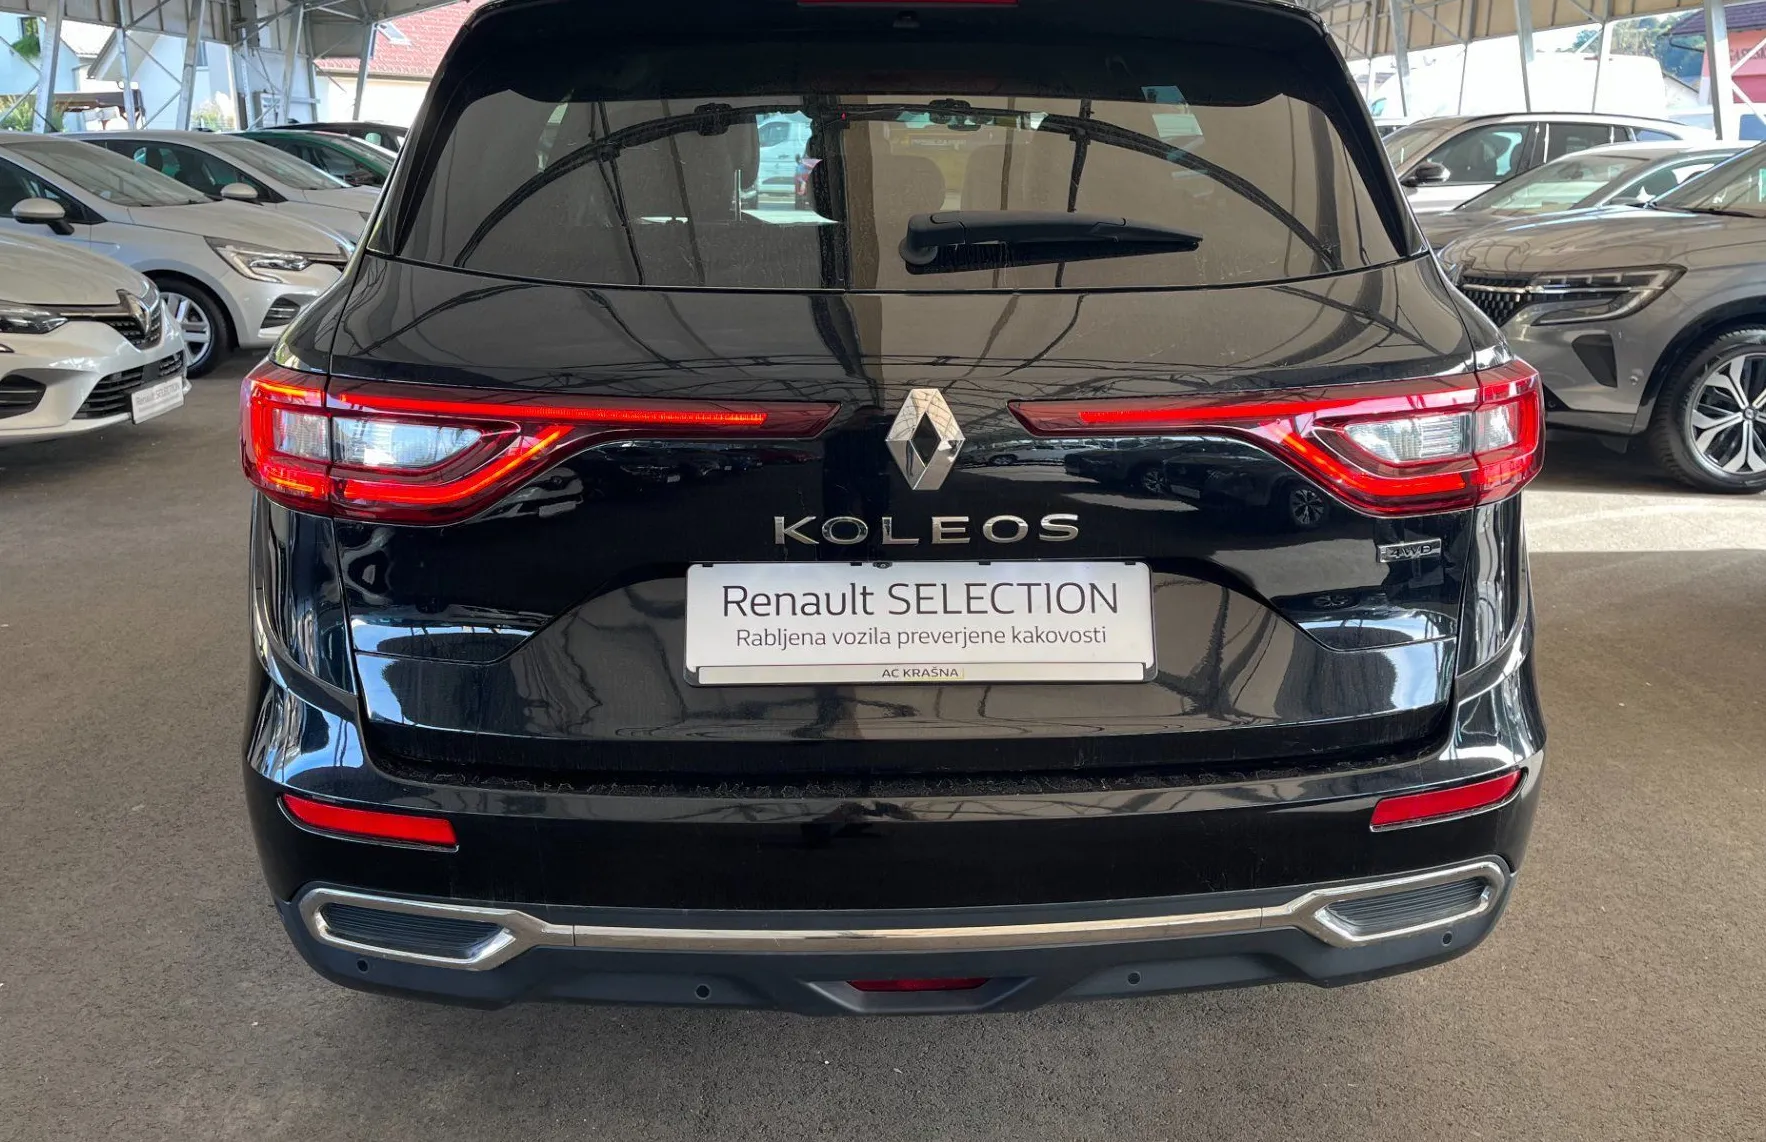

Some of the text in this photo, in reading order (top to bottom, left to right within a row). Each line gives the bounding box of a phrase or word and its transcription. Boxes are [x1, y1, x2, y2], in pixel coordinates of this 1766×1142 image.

[773, 513, 1080, 545] KOLEOS
[722, 582, 1118, 617] Renault SELECTION
[736, 625, 1107, 651] Rabljena vozila preverjene kakovosti
[881, 666, 959, 678] AC KRAŠNA
